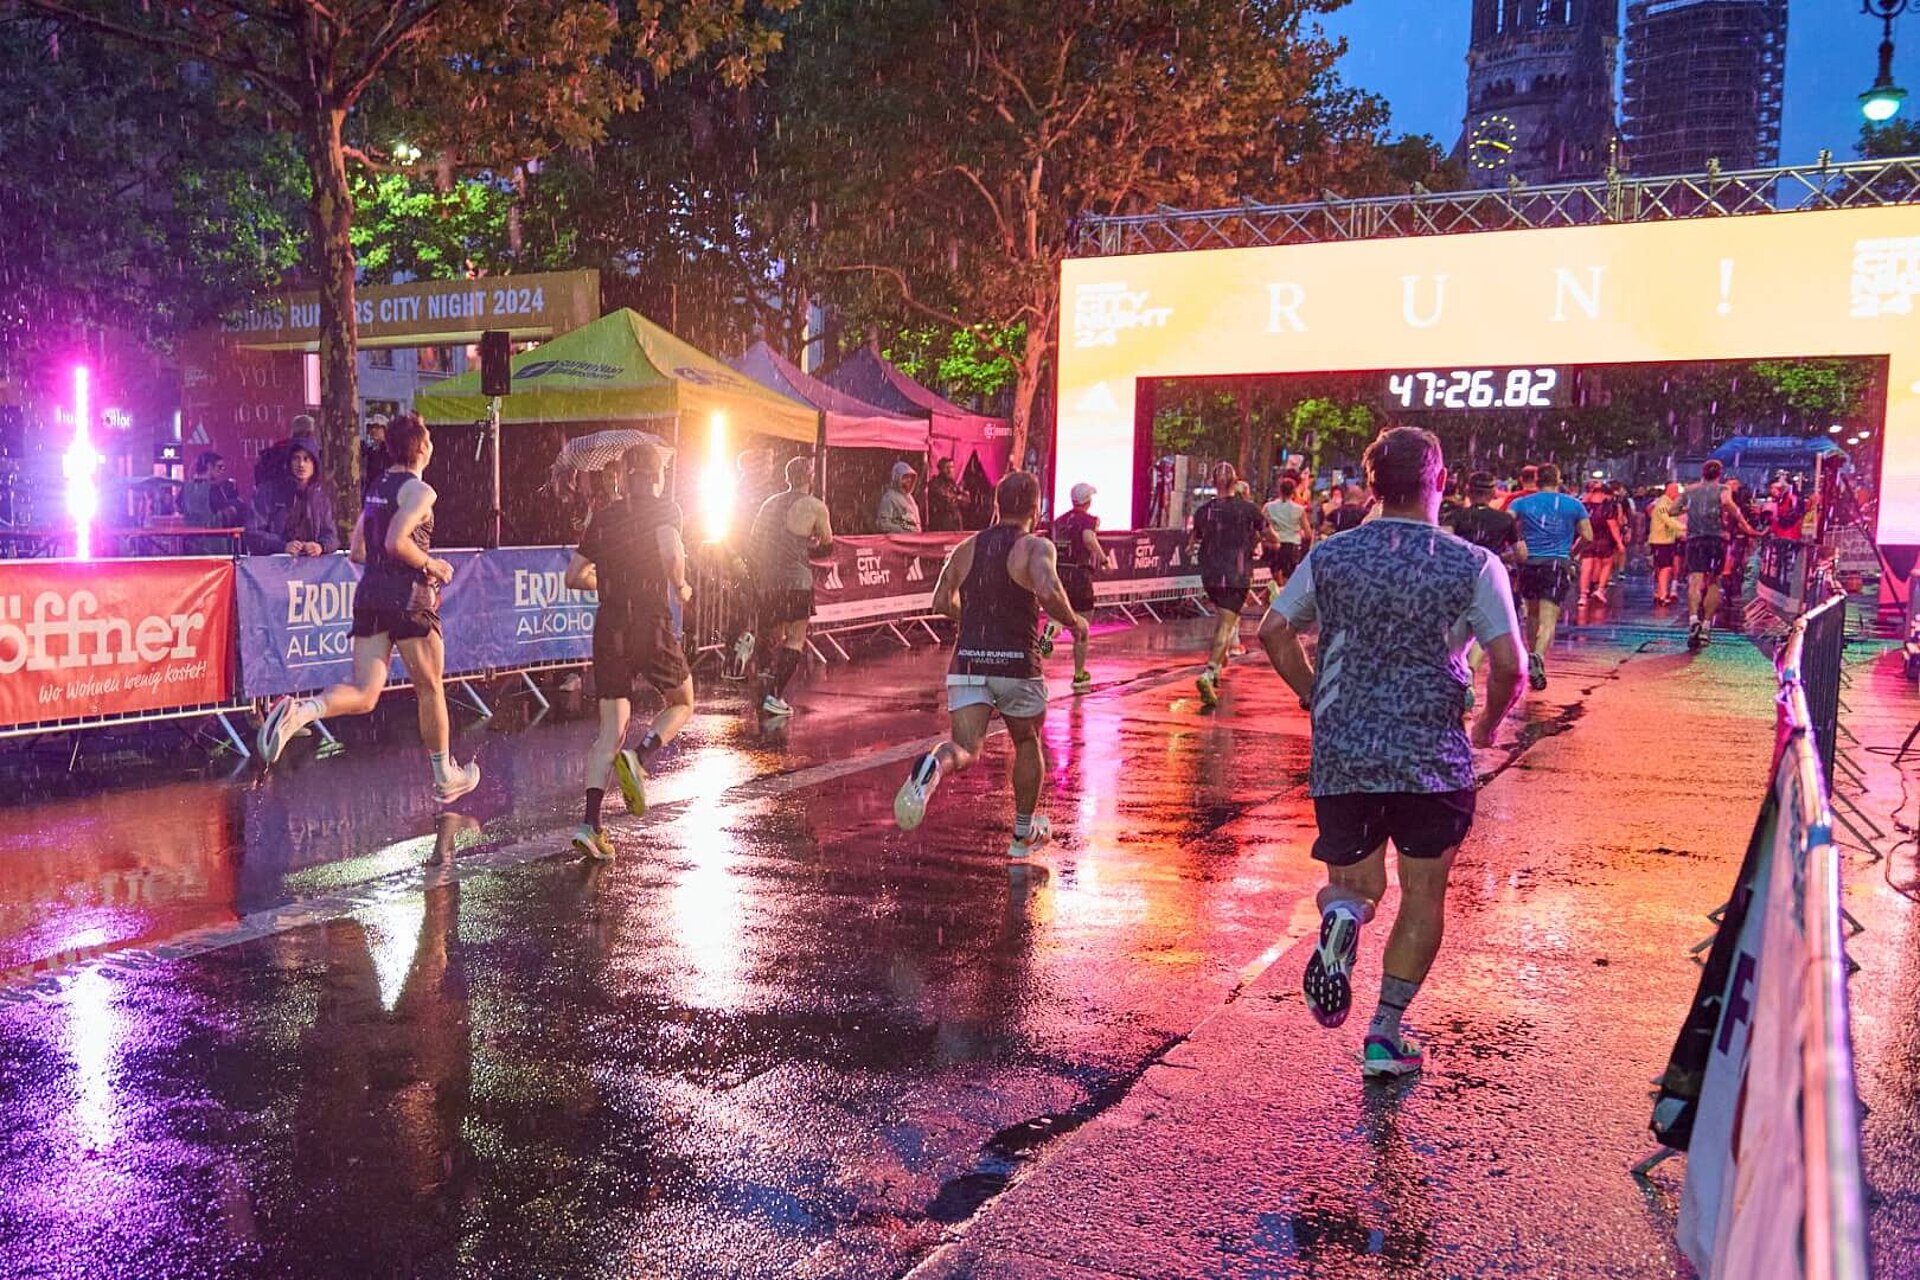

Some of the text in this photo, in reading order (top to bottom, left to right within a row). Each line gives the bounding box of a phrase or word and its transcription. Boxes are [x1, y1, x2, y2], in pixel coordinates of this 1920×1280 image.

[380, 295, 421, 323] CITY
[428, 290, 487, 320] NIGHT
[493, 286, 544, 315] 2024
[1388, 368, 1557, 409] 47:26.82
[1135, 543, 1156, 557] CITY
[857, 556, 882, 571] CITY
[1134, 556, 1160, 569] NIGHT
[858, 570, 890, 586] NIGHT
[67, 672, 120, 699] Wohnen
[125, 666, 162, 694] wenig
[164, 660, 207, 684] kostet!
